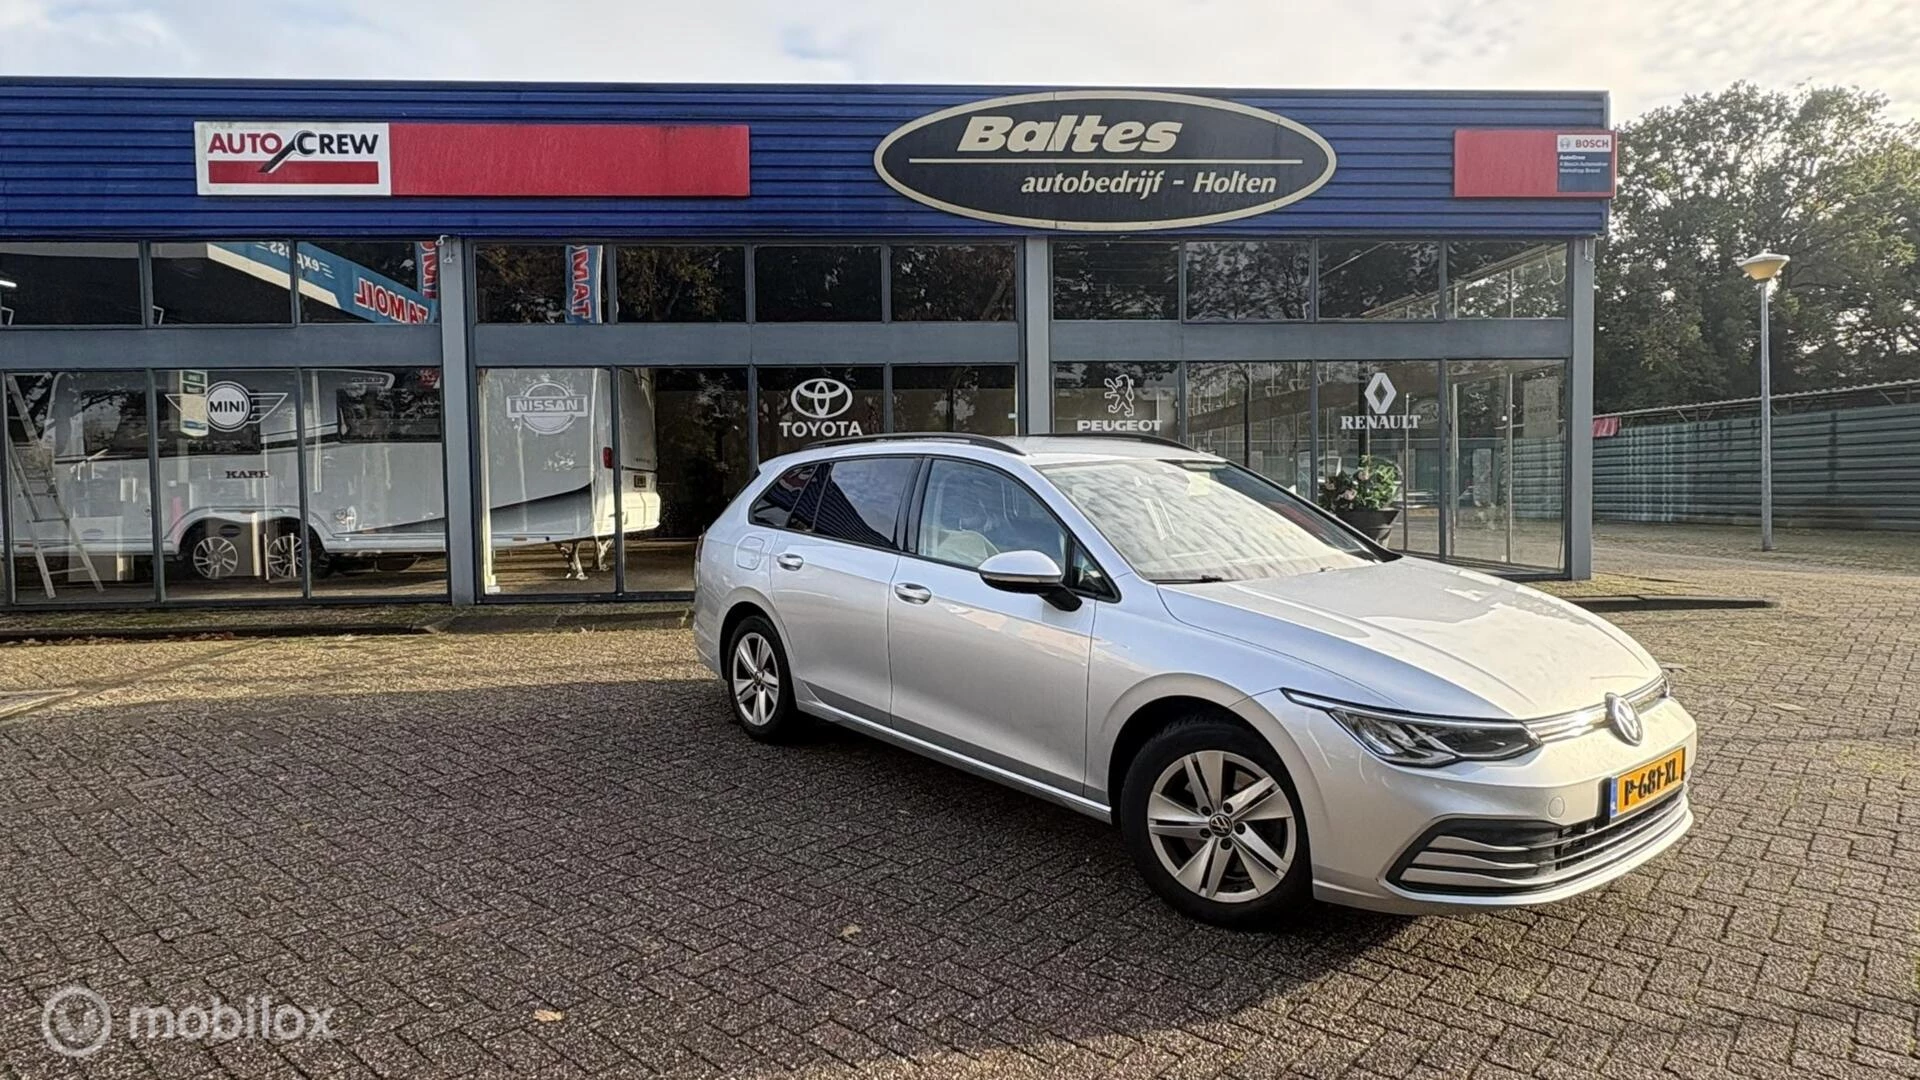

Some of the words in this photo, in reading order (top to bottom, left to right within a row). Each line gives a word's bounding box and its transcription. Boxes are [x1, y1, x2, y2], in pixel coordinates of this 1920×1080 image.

[957, 114, 1183, 153] Baltes
[208, 132, 282, 154] AUTO
[297, 132, 379, 155] CREW
[1575, 139, 1609, 148] BOSCH
[1021, 169, 1165, 200] autobedrijf
[1192, 170, 1277, 194] Holten
[209, 400, 245, 412] MINI
[516, 399, 578, 411] NISSAN
[779, 420, 863, 437] TOYOTA
[1077, 419, 1162, 431] PEUGEOT
[1340, 414, 1421, 430] RENAULT
[1624, 757, 1679, 806] P-681-XL
